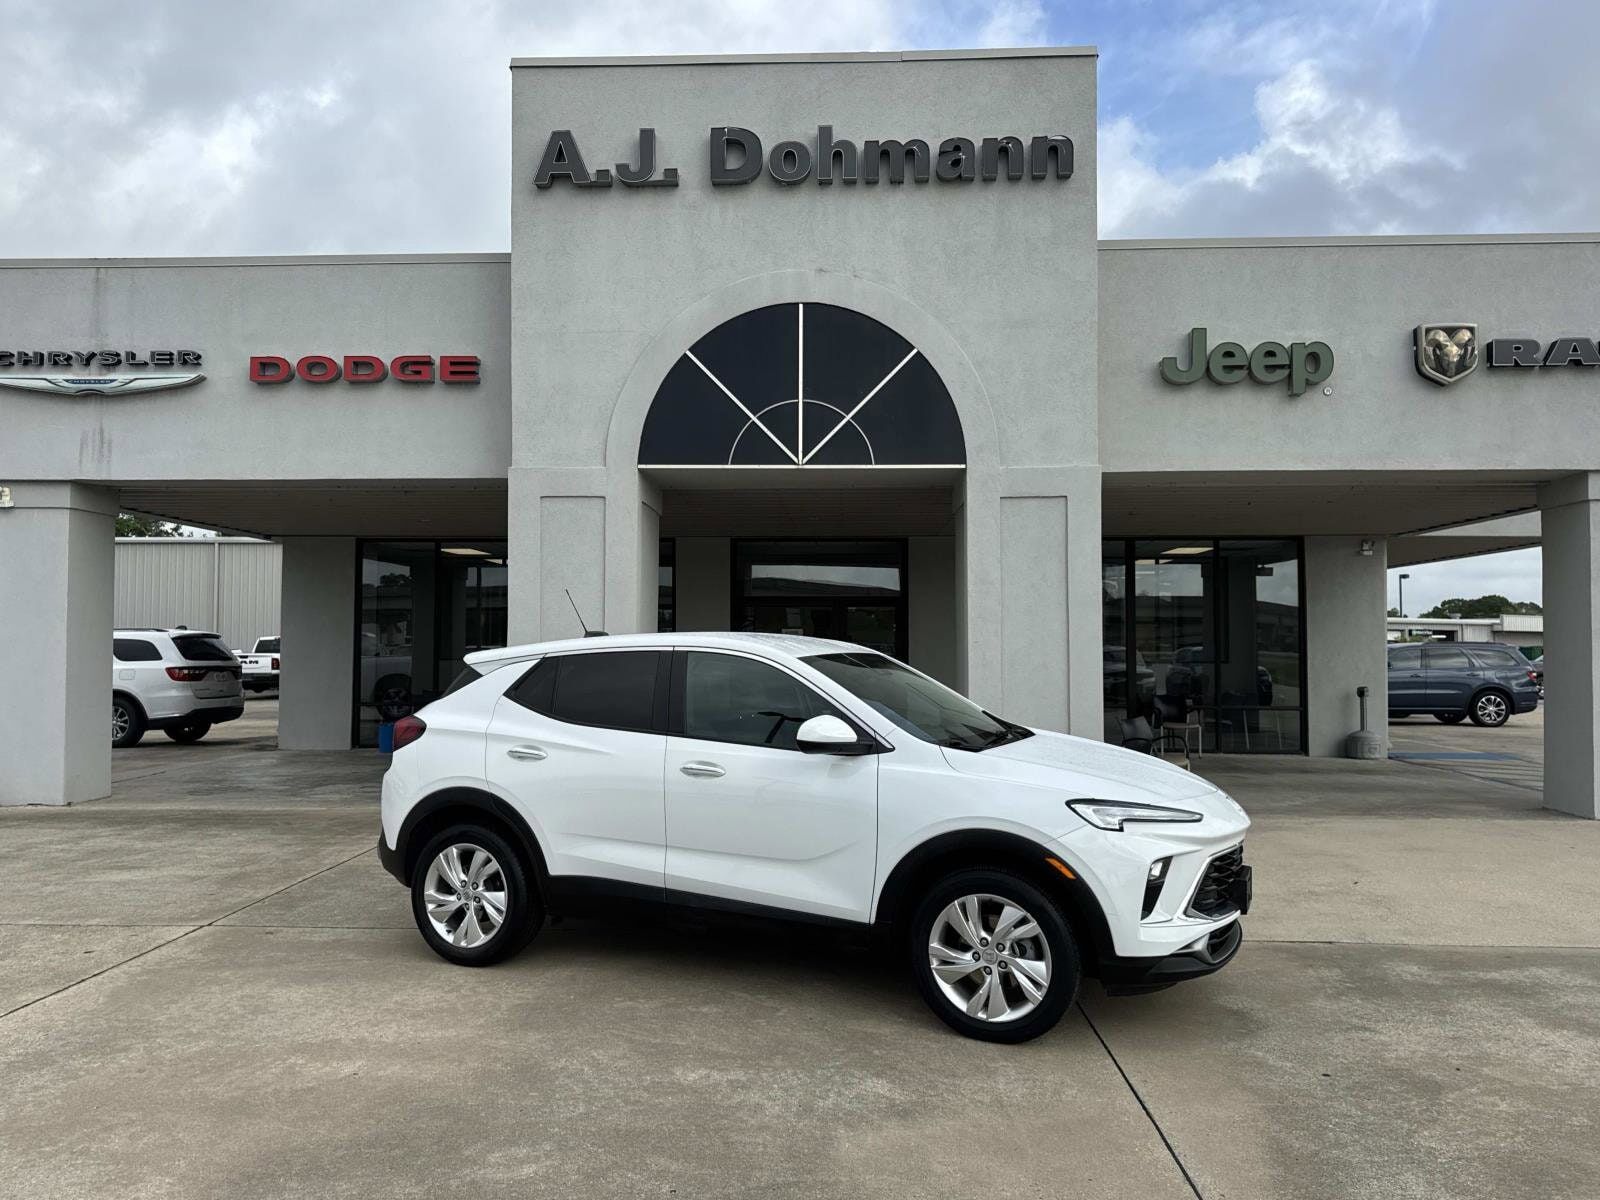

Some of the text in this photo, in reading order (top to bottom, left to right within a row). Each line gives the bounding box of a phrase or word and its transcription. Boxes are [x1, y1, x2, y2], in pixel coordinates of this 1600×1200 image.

[534, 124, 1074, 188] A.J. Dohmann
[249, 355, 480, 384] DODGE
[1160, 327, 1334, 396] Jeep
[1486, 338, 1600, 368] RA
